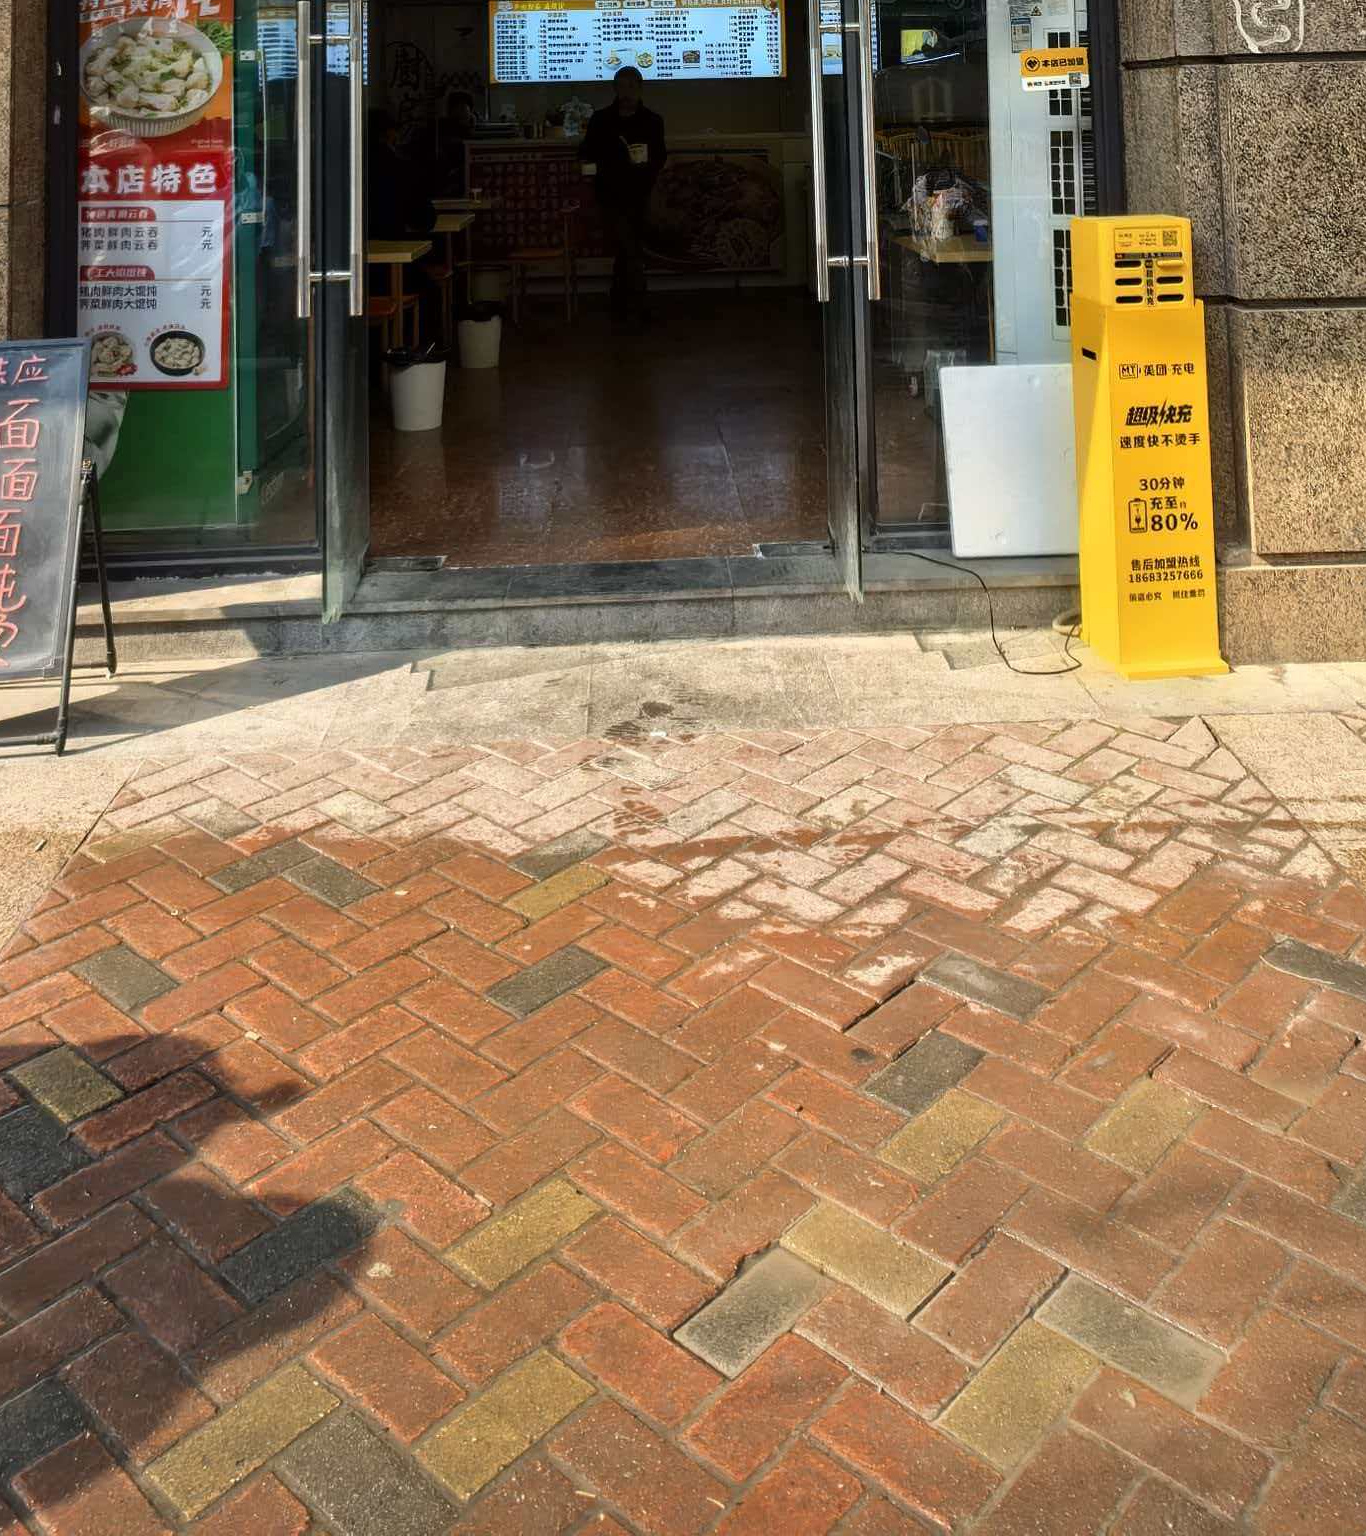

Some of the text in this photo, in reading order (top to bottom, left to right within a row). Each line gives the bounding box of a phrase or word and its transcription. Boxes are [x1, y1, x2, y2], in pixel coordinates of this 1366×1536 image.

[81, 163, 219, 195] 本店特色
[1139, 476, 1186, 492] 30分钟
[1151, 513, 1199, 532] 80%
